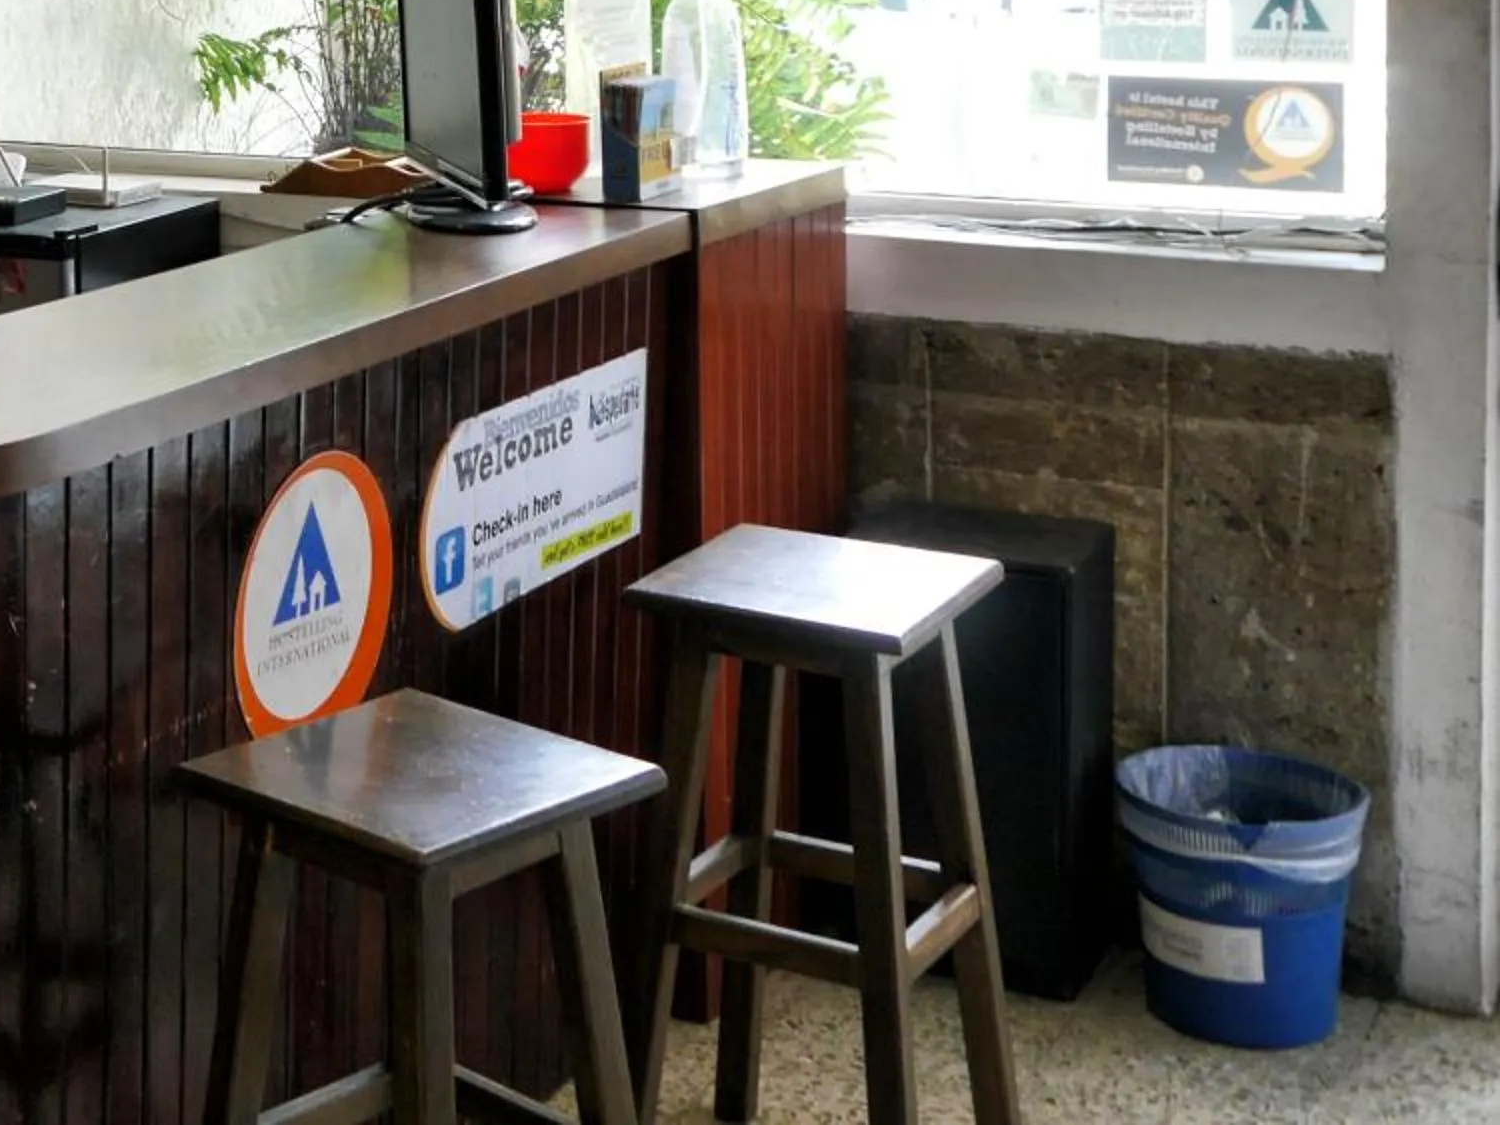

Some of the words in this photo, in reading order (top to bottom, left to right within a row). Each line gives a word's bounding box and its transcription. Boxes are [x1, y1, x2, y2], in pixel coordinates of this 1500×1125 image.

[453, 415, 574, 492] Welcome
[472, 501, 530, 547] Check-in
[533, 490, 564, 517] here
[257, 627, 351, 677] INTERNATIONAL
[268, 613, 343, 653] HOSTELLING
